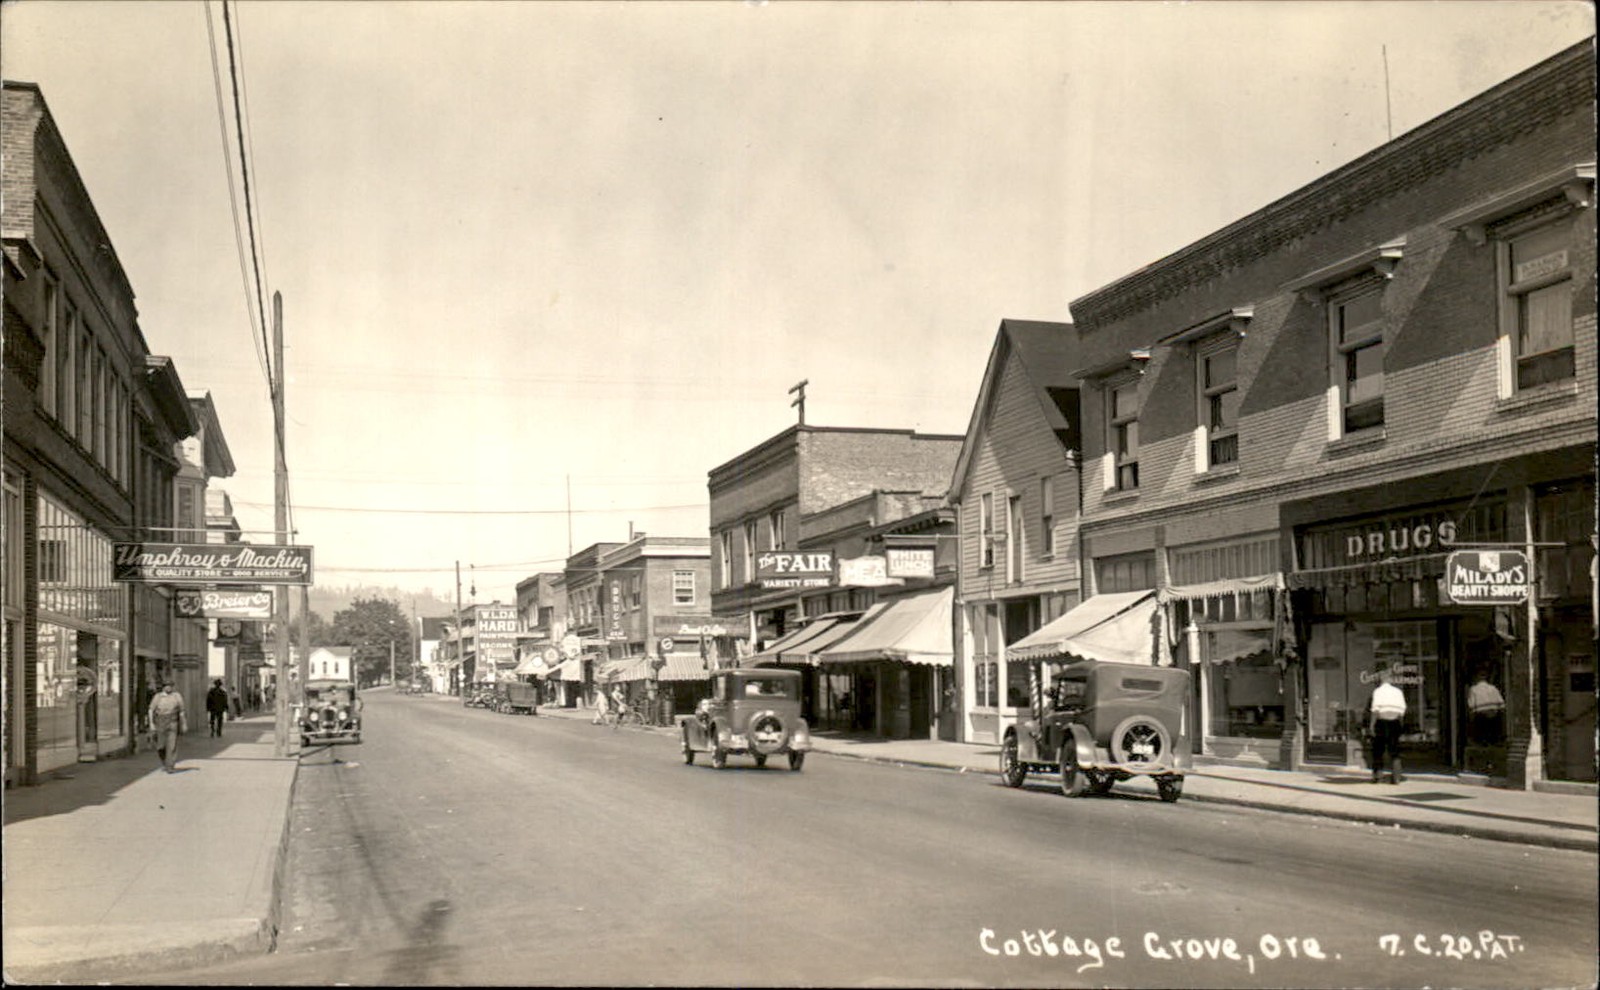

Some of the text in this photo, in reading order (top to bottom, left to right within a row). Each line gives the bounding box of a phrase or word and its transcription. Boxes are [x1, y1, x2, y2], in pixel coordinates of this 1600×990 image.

[1346, 520, 1457, 557] DRUGS
[116, 545, 216, 570] Umphrey
[758, 552, 832, 573] The FAIR
[890, 559, 931, 571] LUNCH
[137, 568, 155, 577] THE
[155, 568, 192, 577] QUALITY
[194, 569, 222, 577] STORE
[763, 578, 829, 588] VARIETY STORE
[1451, 584, 1528, 599] BEAUTY SHOPPE
[612, 586, 620, 630] DRUGS
